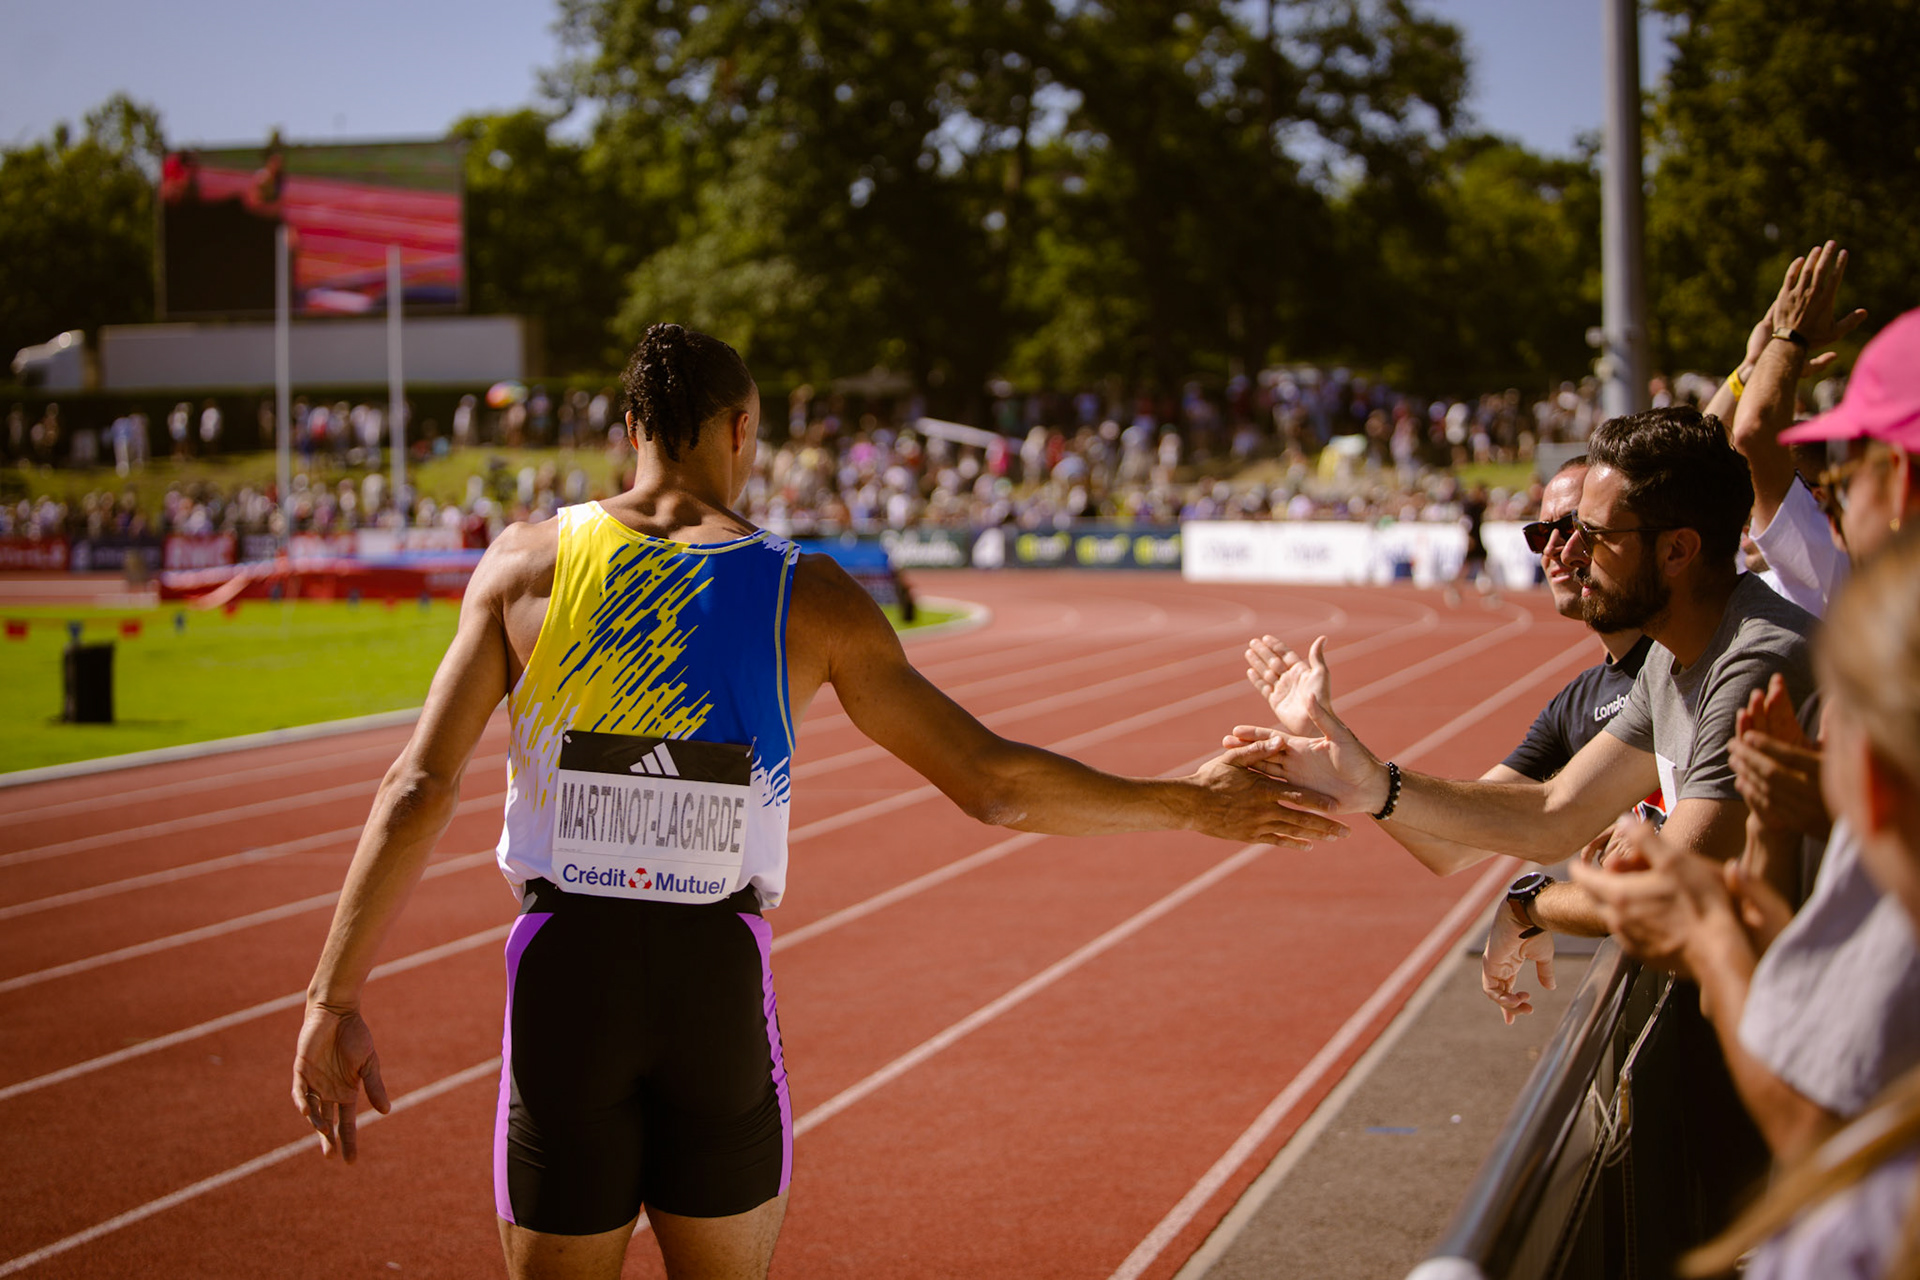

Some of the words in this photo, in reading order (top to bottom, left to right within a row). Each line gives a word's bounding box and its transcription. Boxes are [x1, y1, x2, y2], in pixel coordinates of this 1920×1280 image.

[558, 782, 745, 854] MARTINOT-LAGARDE
[562, 863, 627, 888] Crédit
[655, 872, 727, 895] Mutuel
